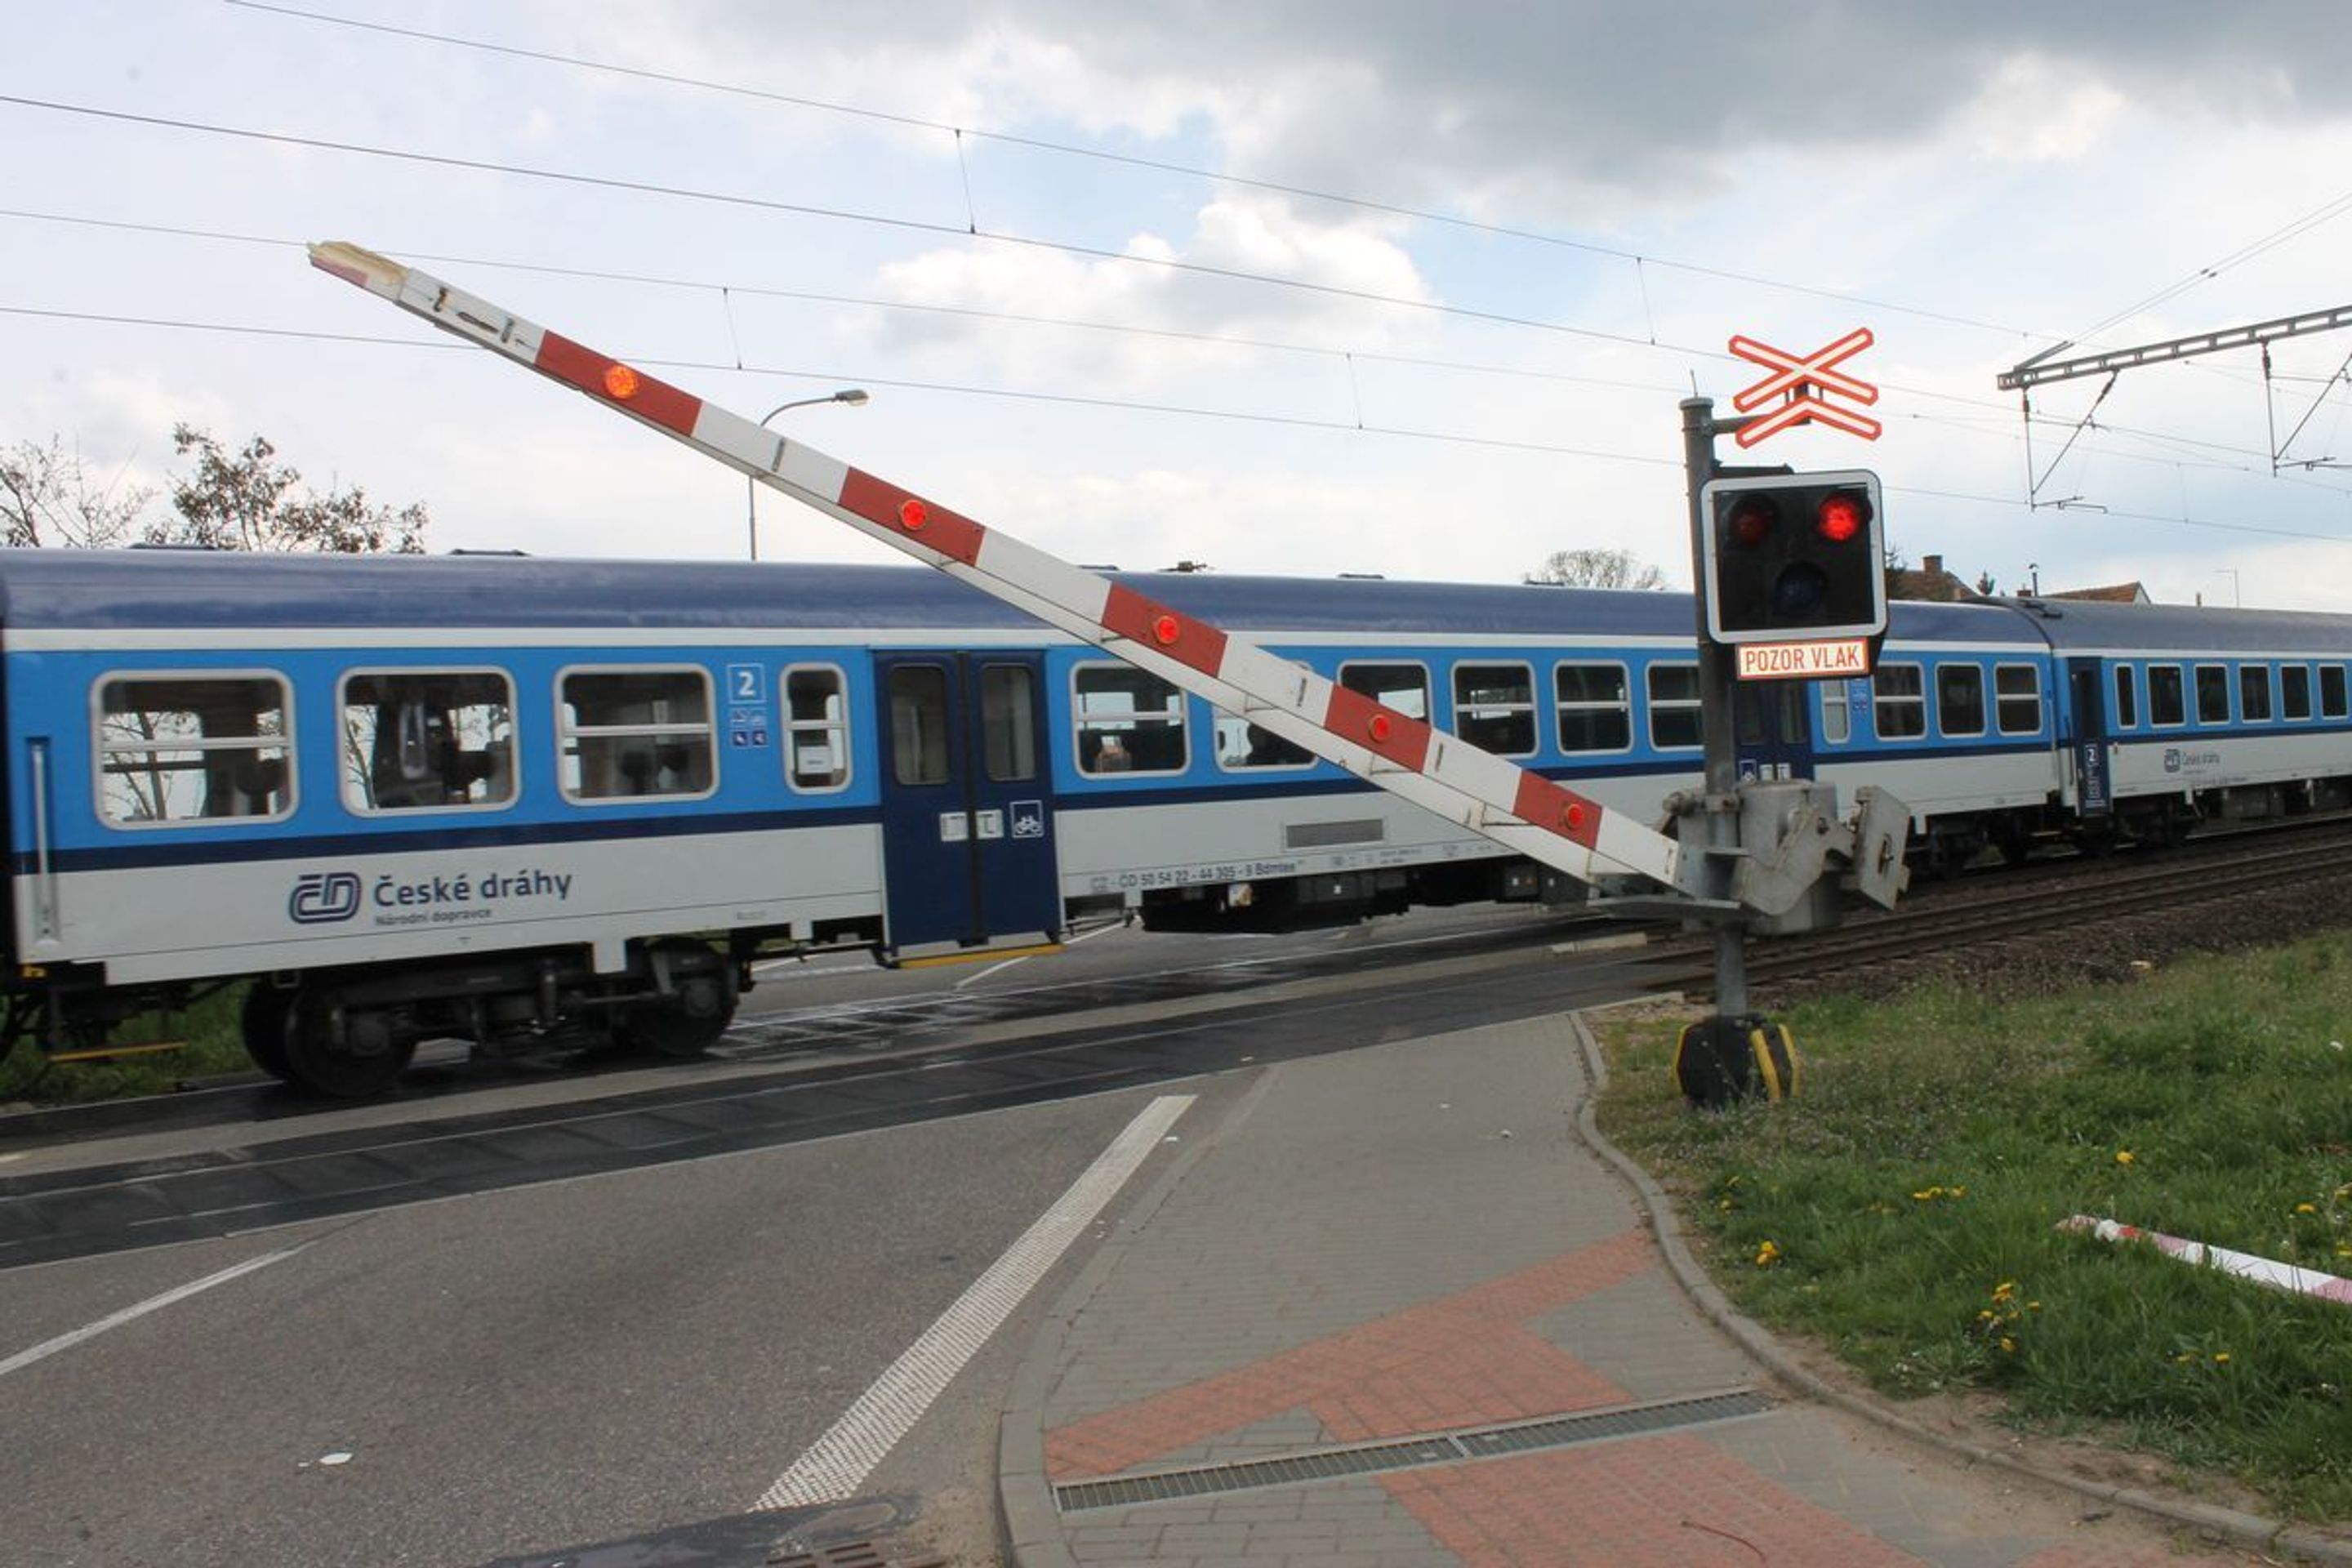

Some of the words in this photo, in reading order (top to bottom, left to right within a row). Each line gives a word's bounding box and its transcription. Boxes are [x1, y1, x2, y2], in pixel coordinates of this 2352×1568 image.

[1745, 648, 1804, 672] POZOR
[1811, 644, 1860, 668] VLAK
[737, 671, 756, 696] 2
[373, 874, 471, 906] České
[479, 869, 572, 900] dráhy
[1158, 871, 1173, 884] 54
[1200, 867, 1213, 880] 44
